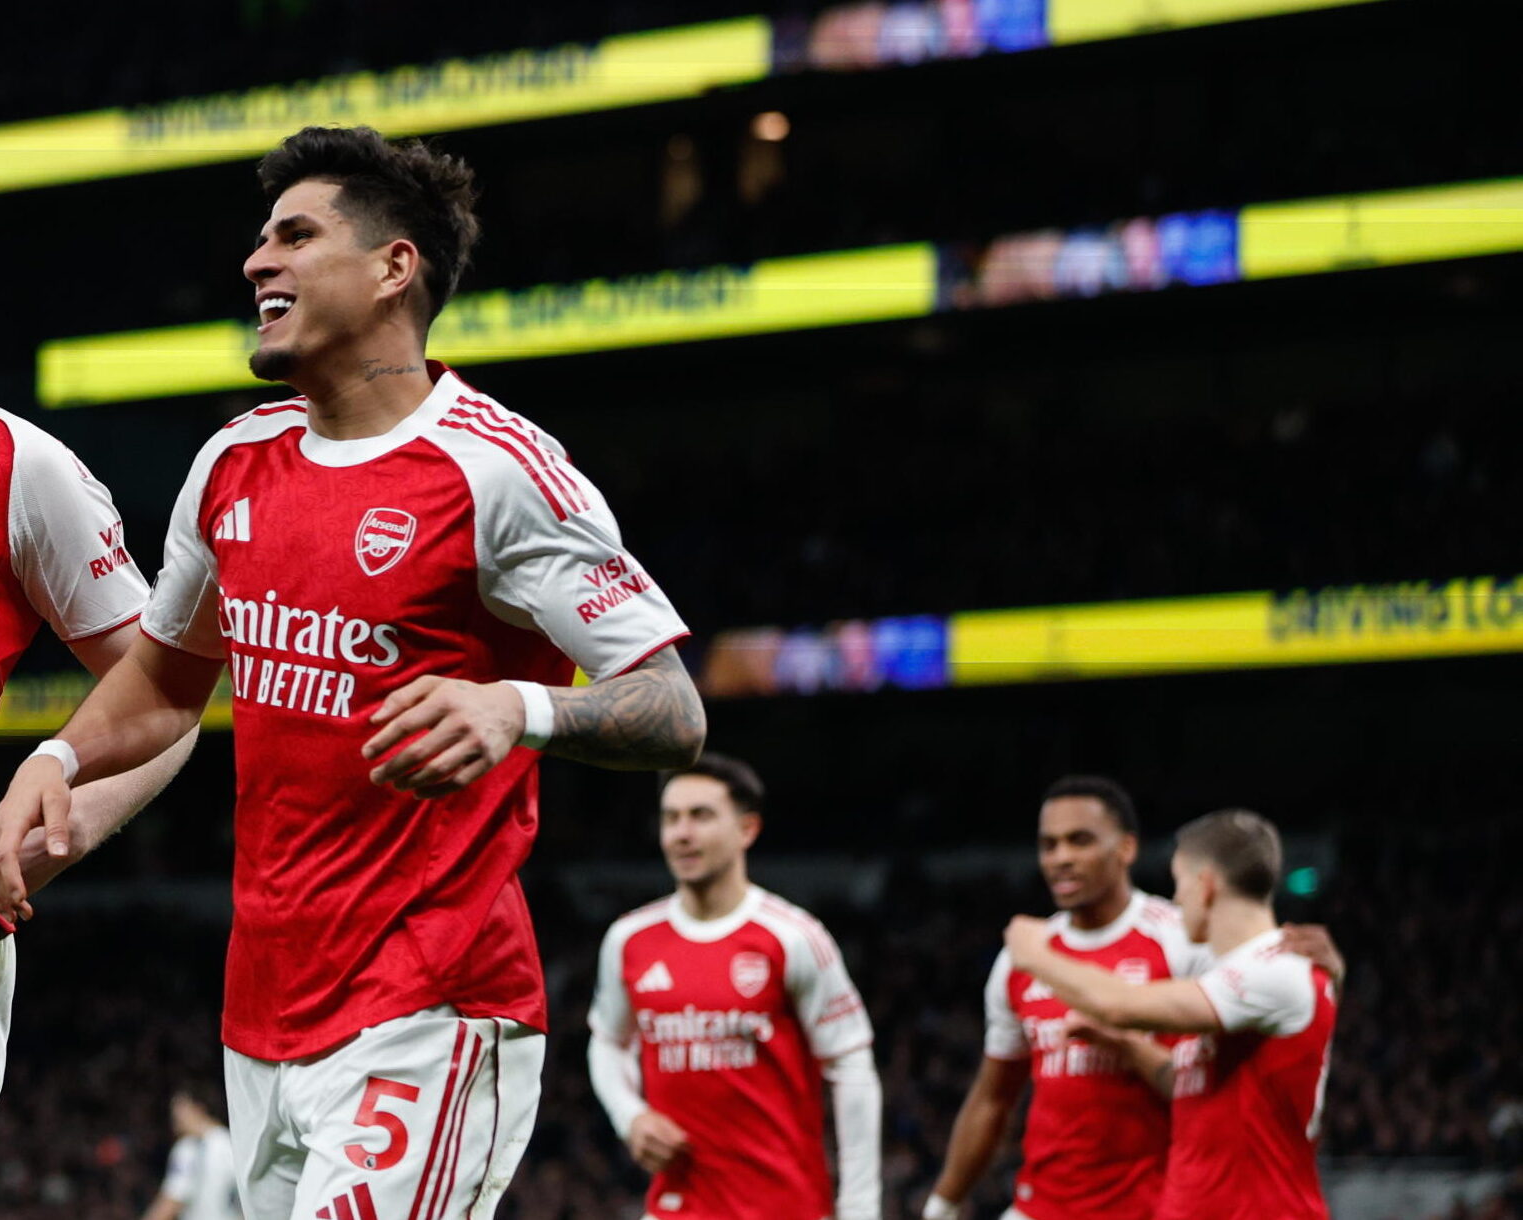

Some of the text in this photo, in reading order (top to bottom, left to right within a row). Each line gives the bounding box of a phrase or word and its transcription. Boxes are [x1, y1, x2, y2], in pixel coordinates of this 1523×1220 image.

[366, 517, 409, 535] Arsenal
[256, 659, 356, 718] BETTER
[343, 1076, 420, 1171] 5
